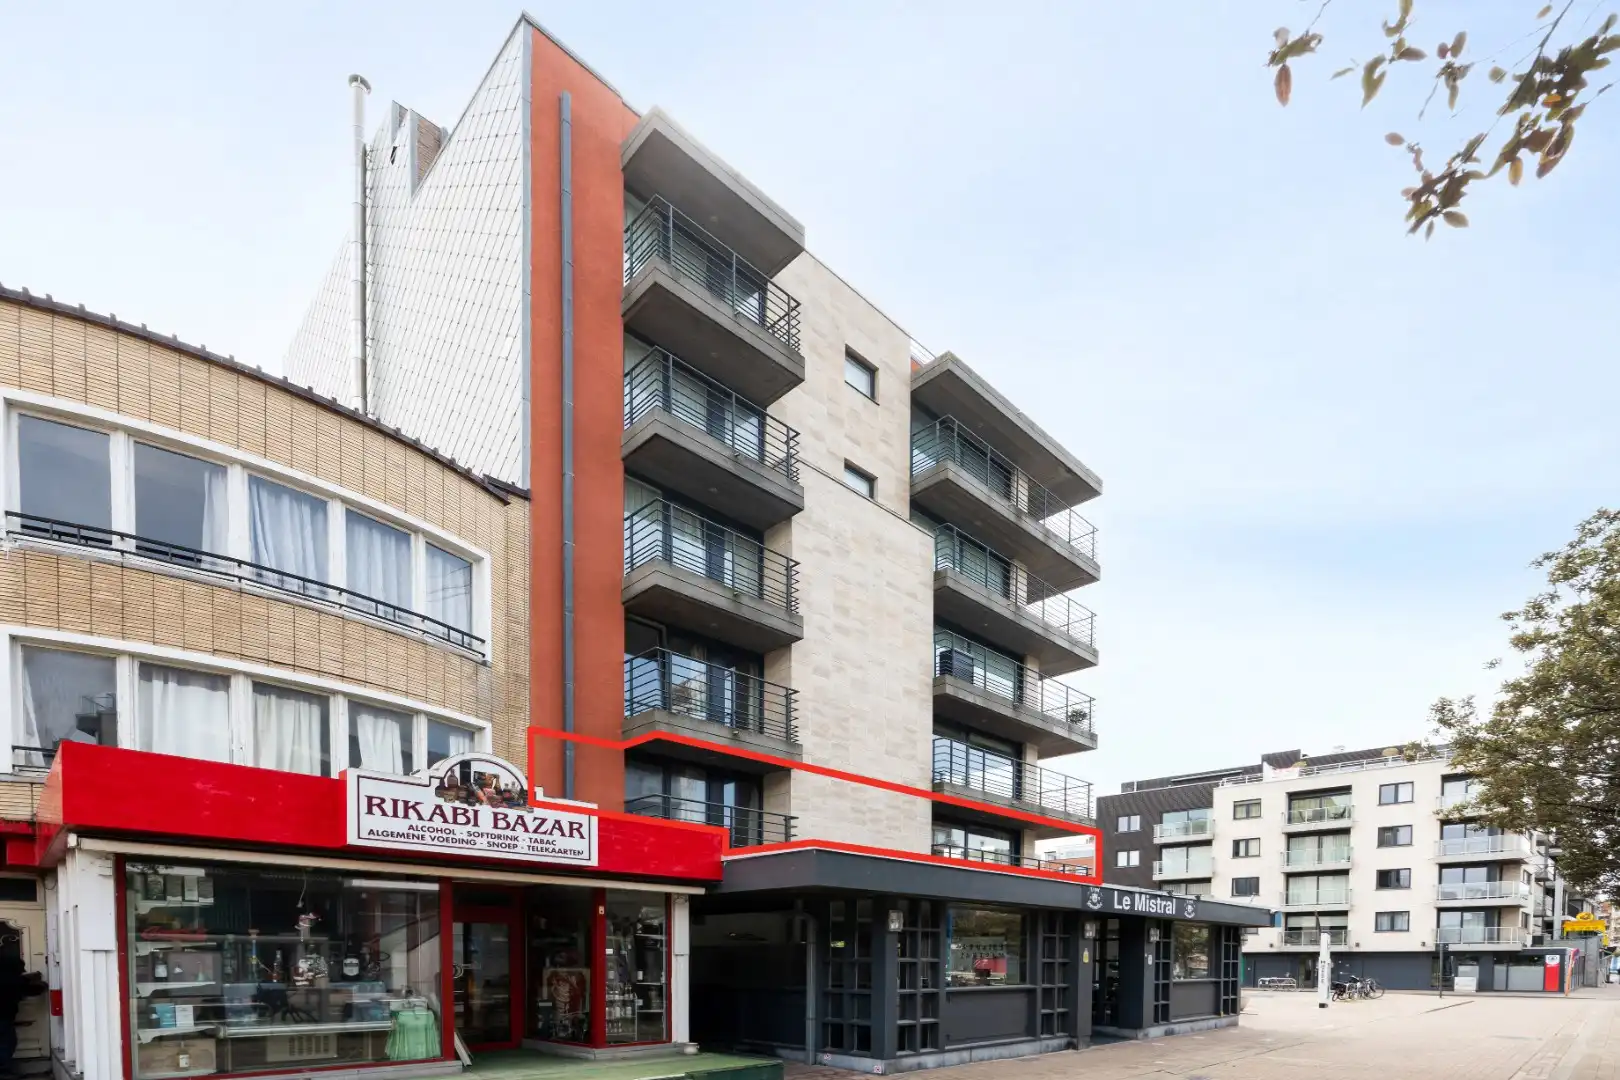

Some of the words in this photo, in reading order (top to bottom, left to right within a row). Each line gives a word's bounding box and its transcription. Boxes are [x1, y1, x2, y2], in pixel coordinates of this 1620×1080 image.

[364, 795, 480, 827] RIKABI
[492, 811, 586, 840] BAZAR
[368, 828, 426, 841] ALGEMENE
[429, 834, 477, 846] VOEDING
[486, 840, 518, 850] SNOEP
[526, 844, 584, 856] TELEKAARTEN
[408, 824, 457, 836] ALCOHOL
[466, 831, 520, 842] SOFTDRINK
[528, 837, 557, 846] TABAC
[1113, 890, 1131, 910] Le
[1134, 893, 1176, 915] Mistral
